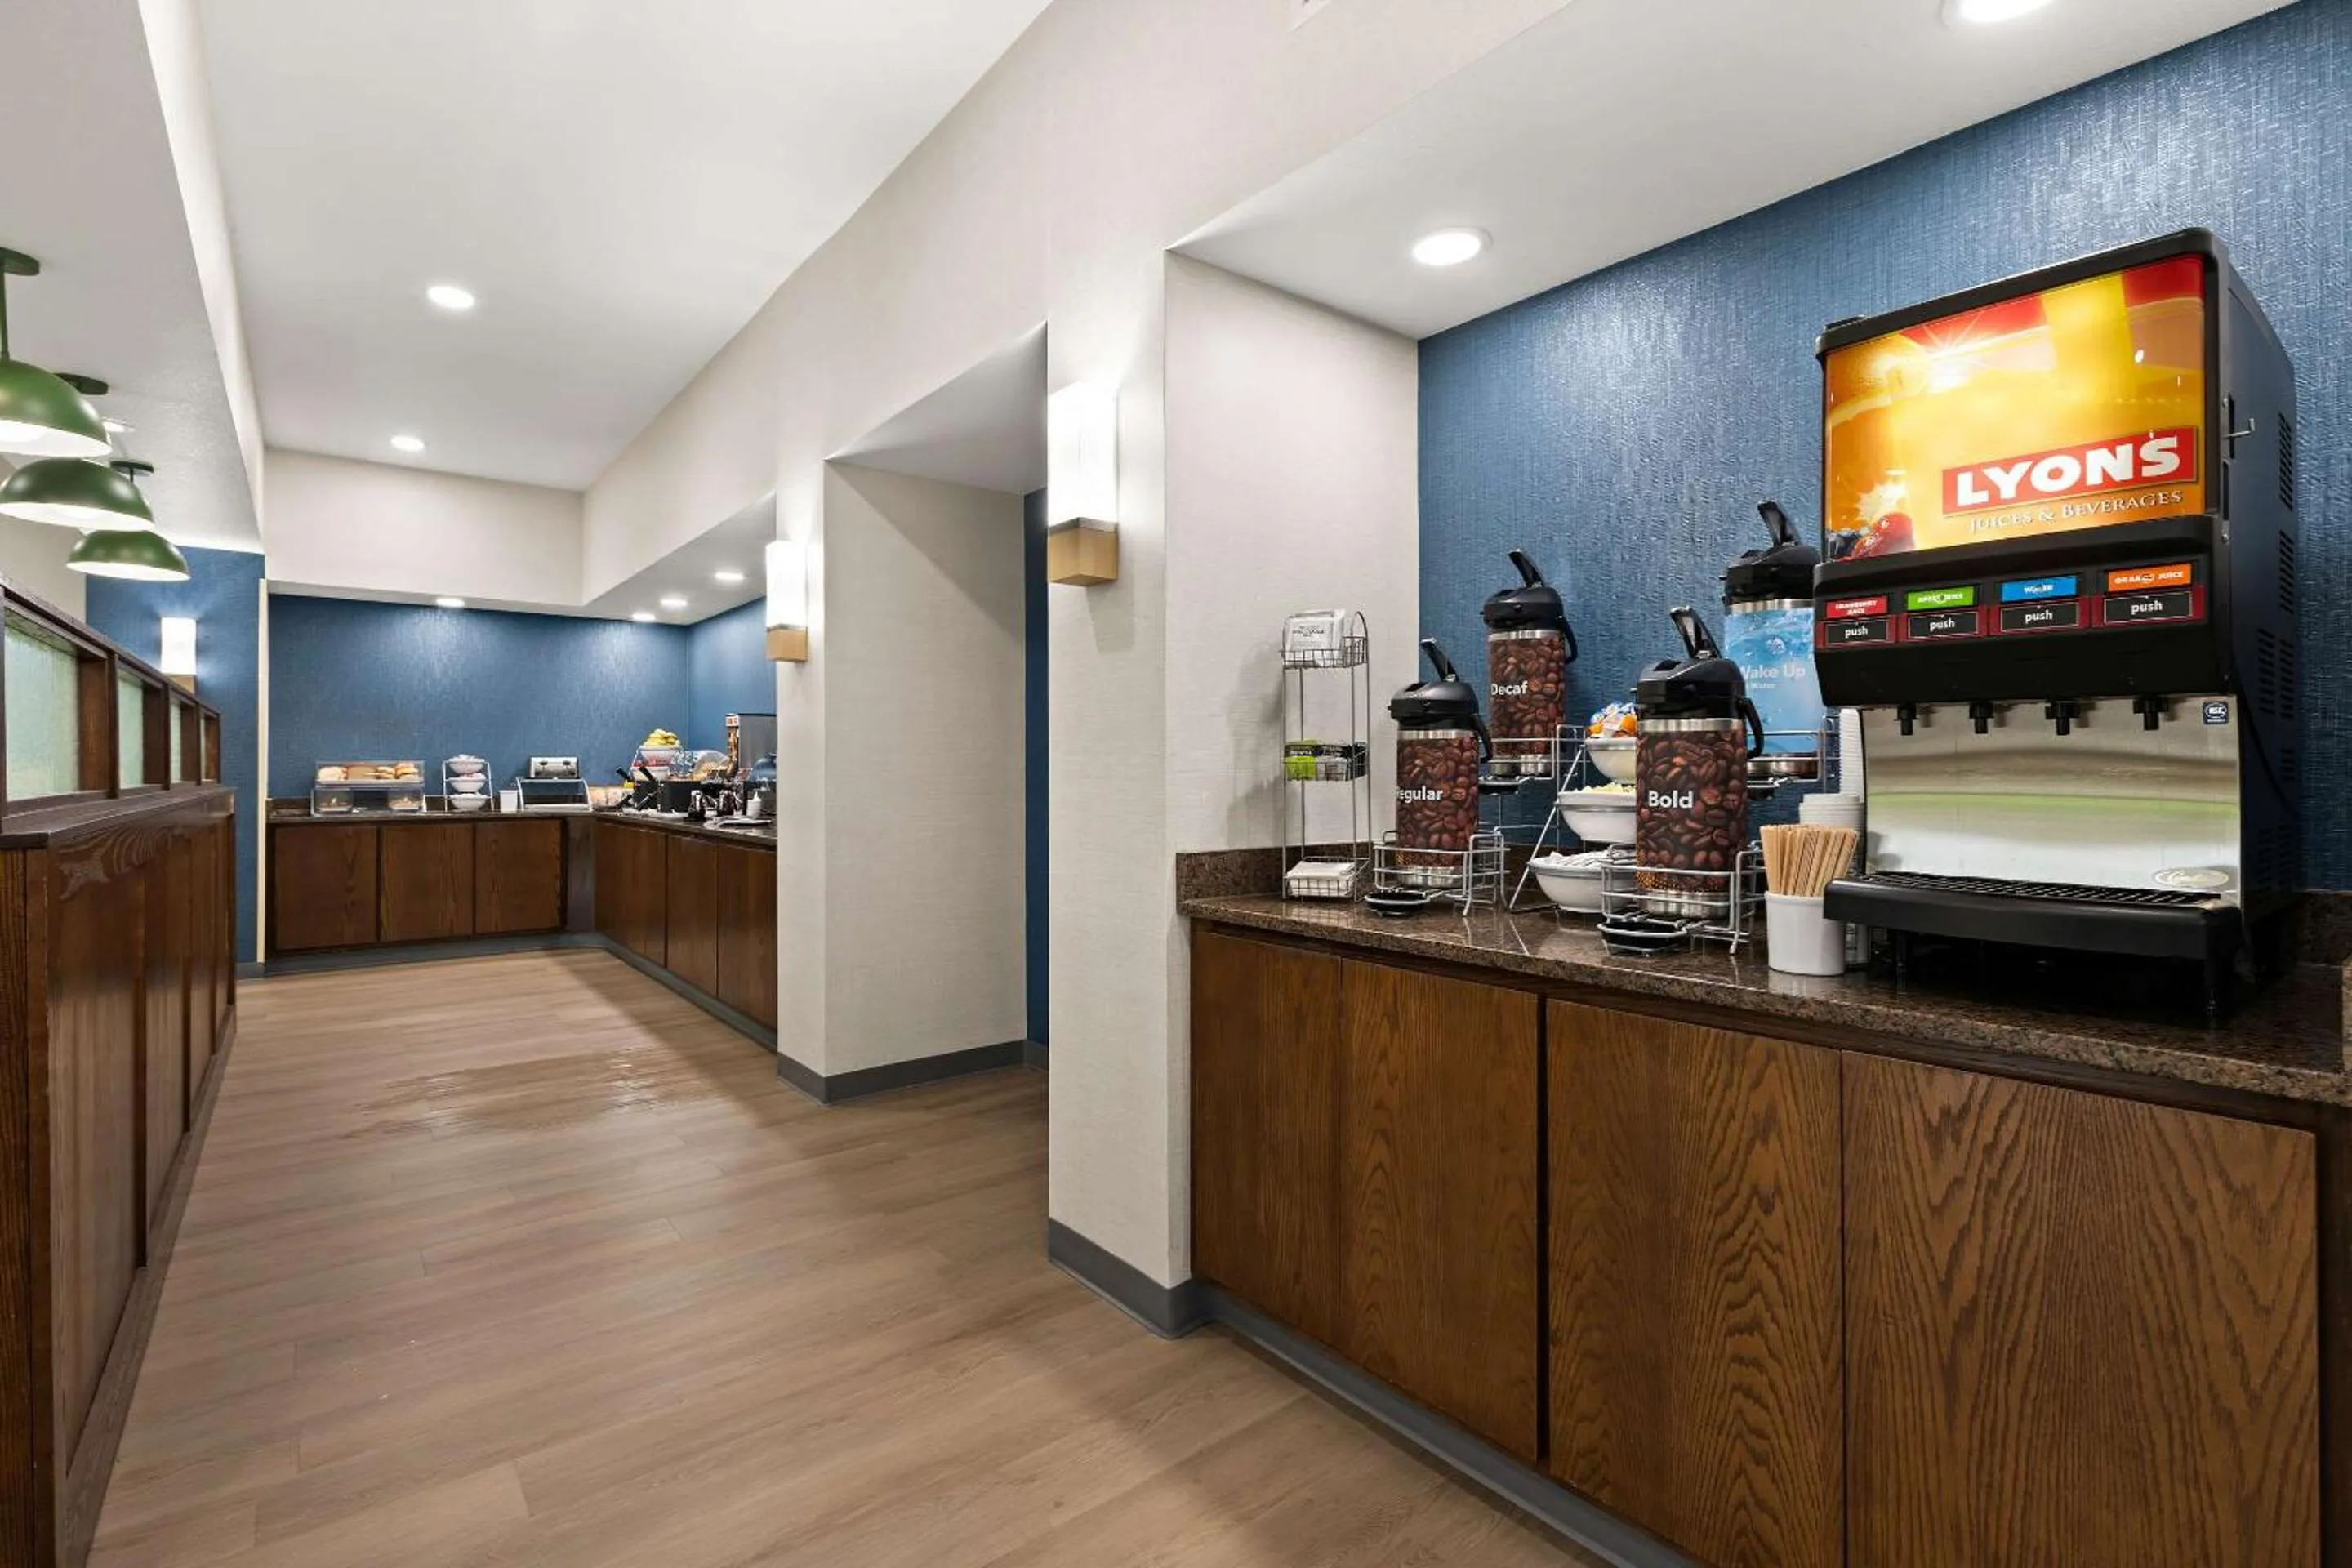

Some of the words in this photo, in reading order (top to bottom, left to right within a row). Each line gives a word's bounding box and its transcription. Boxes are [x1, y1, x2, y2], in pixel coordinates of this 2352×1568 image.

[1957, 434, 2181, 506] LYONS
[1971, 510, 2032, 534] JUICES
[2038, 507, 2055, 522] &
[2061, 490, 2183, 518] BEVERAGES
[2131, 600, 2163, 615] push
[1930, 617, 1955, 633] push
[2025, 609, 2052, 625] push
[1845, 625, 1869, 639] push
[1784, 662, 1806, 681] Up
[1490, 680, 1528, 696] Decaf
[1396, 785, 1443, 804] egular
[1648, 790, 1694, 808] Bold
